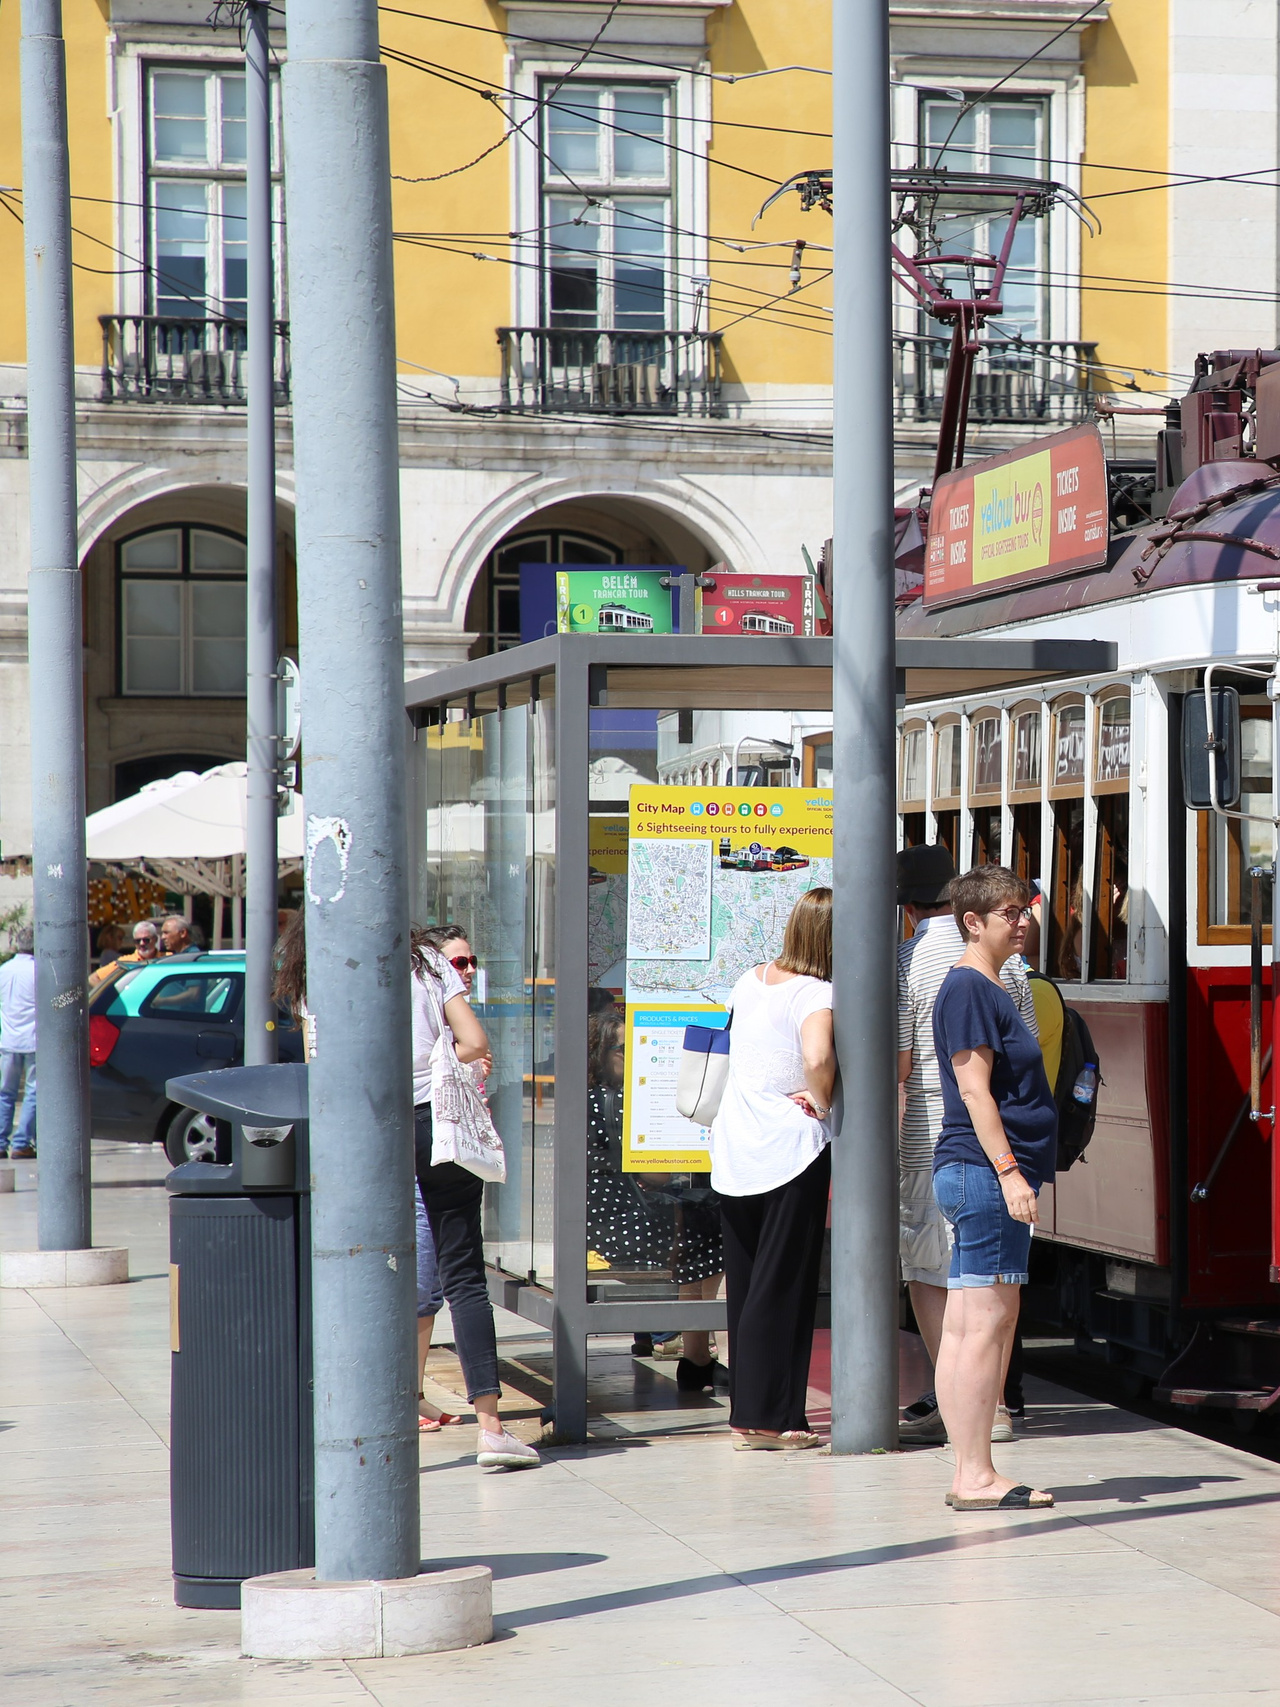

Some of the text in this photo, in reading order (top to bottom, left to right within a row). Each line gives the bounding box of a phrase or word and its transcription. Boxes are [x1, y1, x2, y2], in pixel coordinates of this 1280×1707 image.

[1057, 466, 1079, 497] TICKETS
[949, 504, 970, 531] TICKETS
[981, 481, 1031, 536] yellow bus
[1058, 505, 1077, 535] INSIDE
[950, 540, 967, 566] INSIDE
[602, 574, 638, 589] BELÉM
[593, 589, 649, 599] TRAMCAR TOUR
[727, 589, 785, 598] HILLS TRAMCAR TOUR
[804, 581, 812, 616] TRAM
[580, 609, 585, 619] 1
[720, 610, 726, 622] 1
[637, 803, 685, 815] City Map
[637, 822, 644, 832] 6
[647, 822, 707, 835] Sightseeing
[710, 825, 737, 834] tours
[740, 825, 751, 834] to
[754, 824, 777, 836] fully
[87, 878, 168, 926] BAR
[461, 1139, 486, 1158] ROMA
